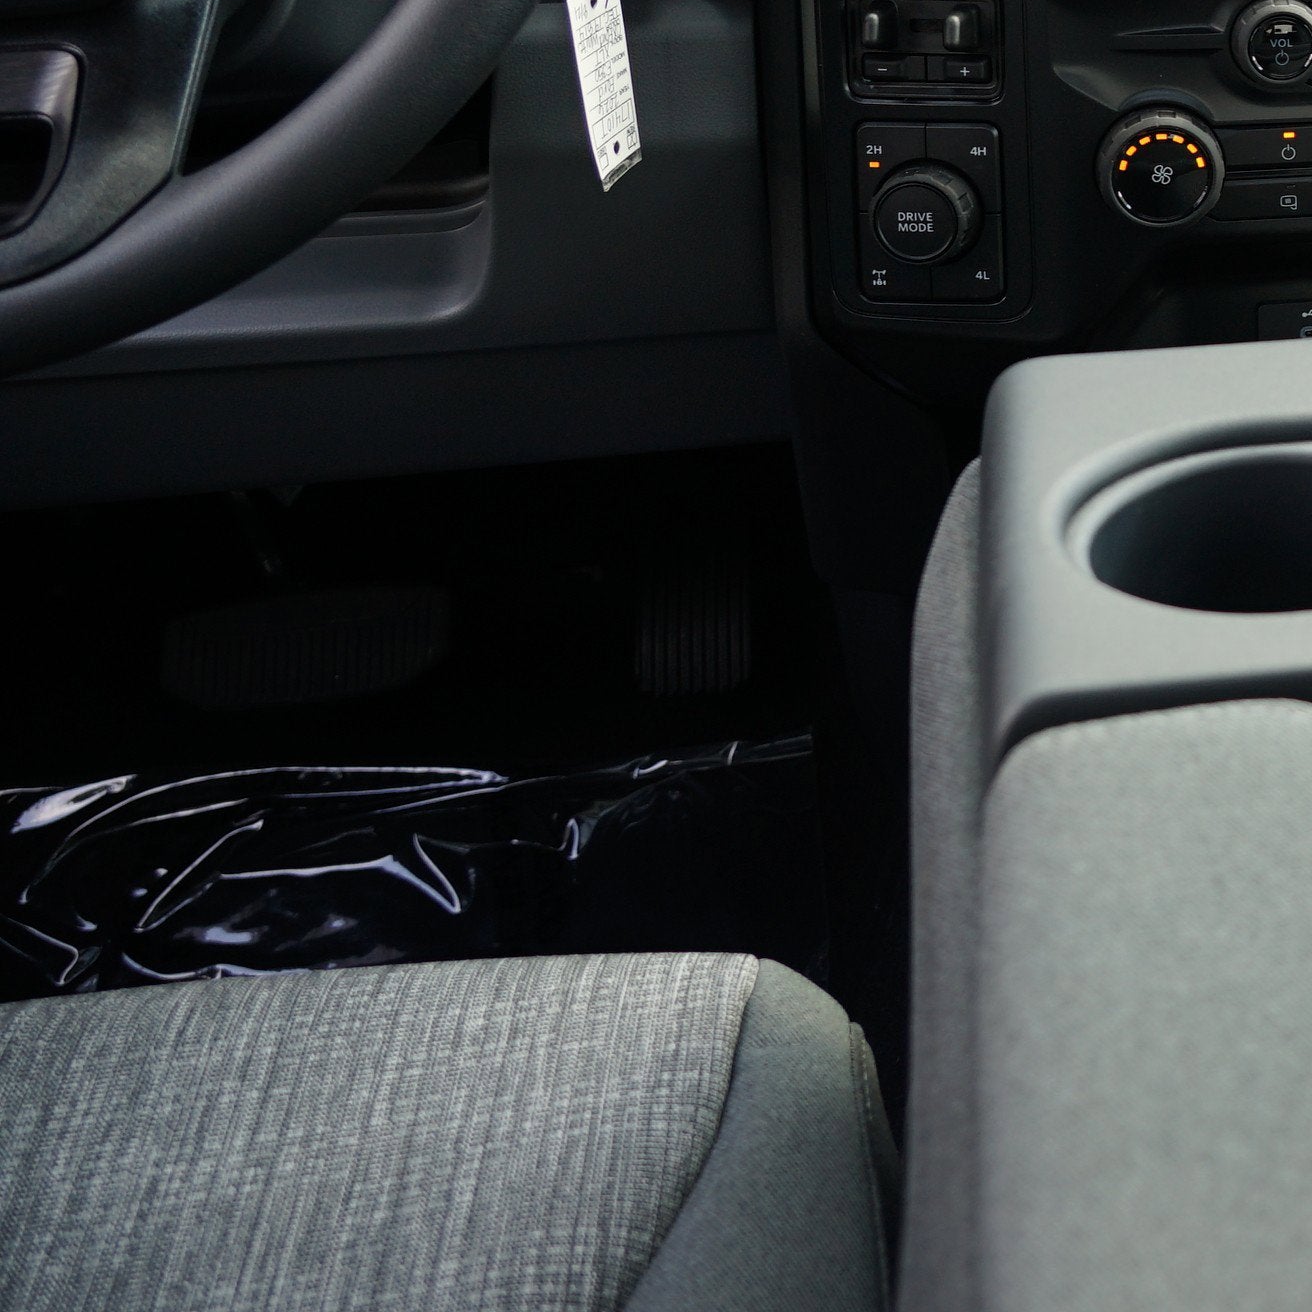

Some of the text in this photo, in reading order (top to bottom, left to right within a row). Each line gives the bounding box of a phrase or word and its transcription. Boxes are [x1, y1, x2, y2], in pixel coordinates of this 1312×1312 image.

[1270, 38, 1294, 48] VOL
[866, 145, 883, 155] 2H
[970, 146, 987, 156] 4H
[898, 212, 934, 222] DRIVE
[898, 223, 934, 233] MODE
[975, 270, 991, 280] 4L
